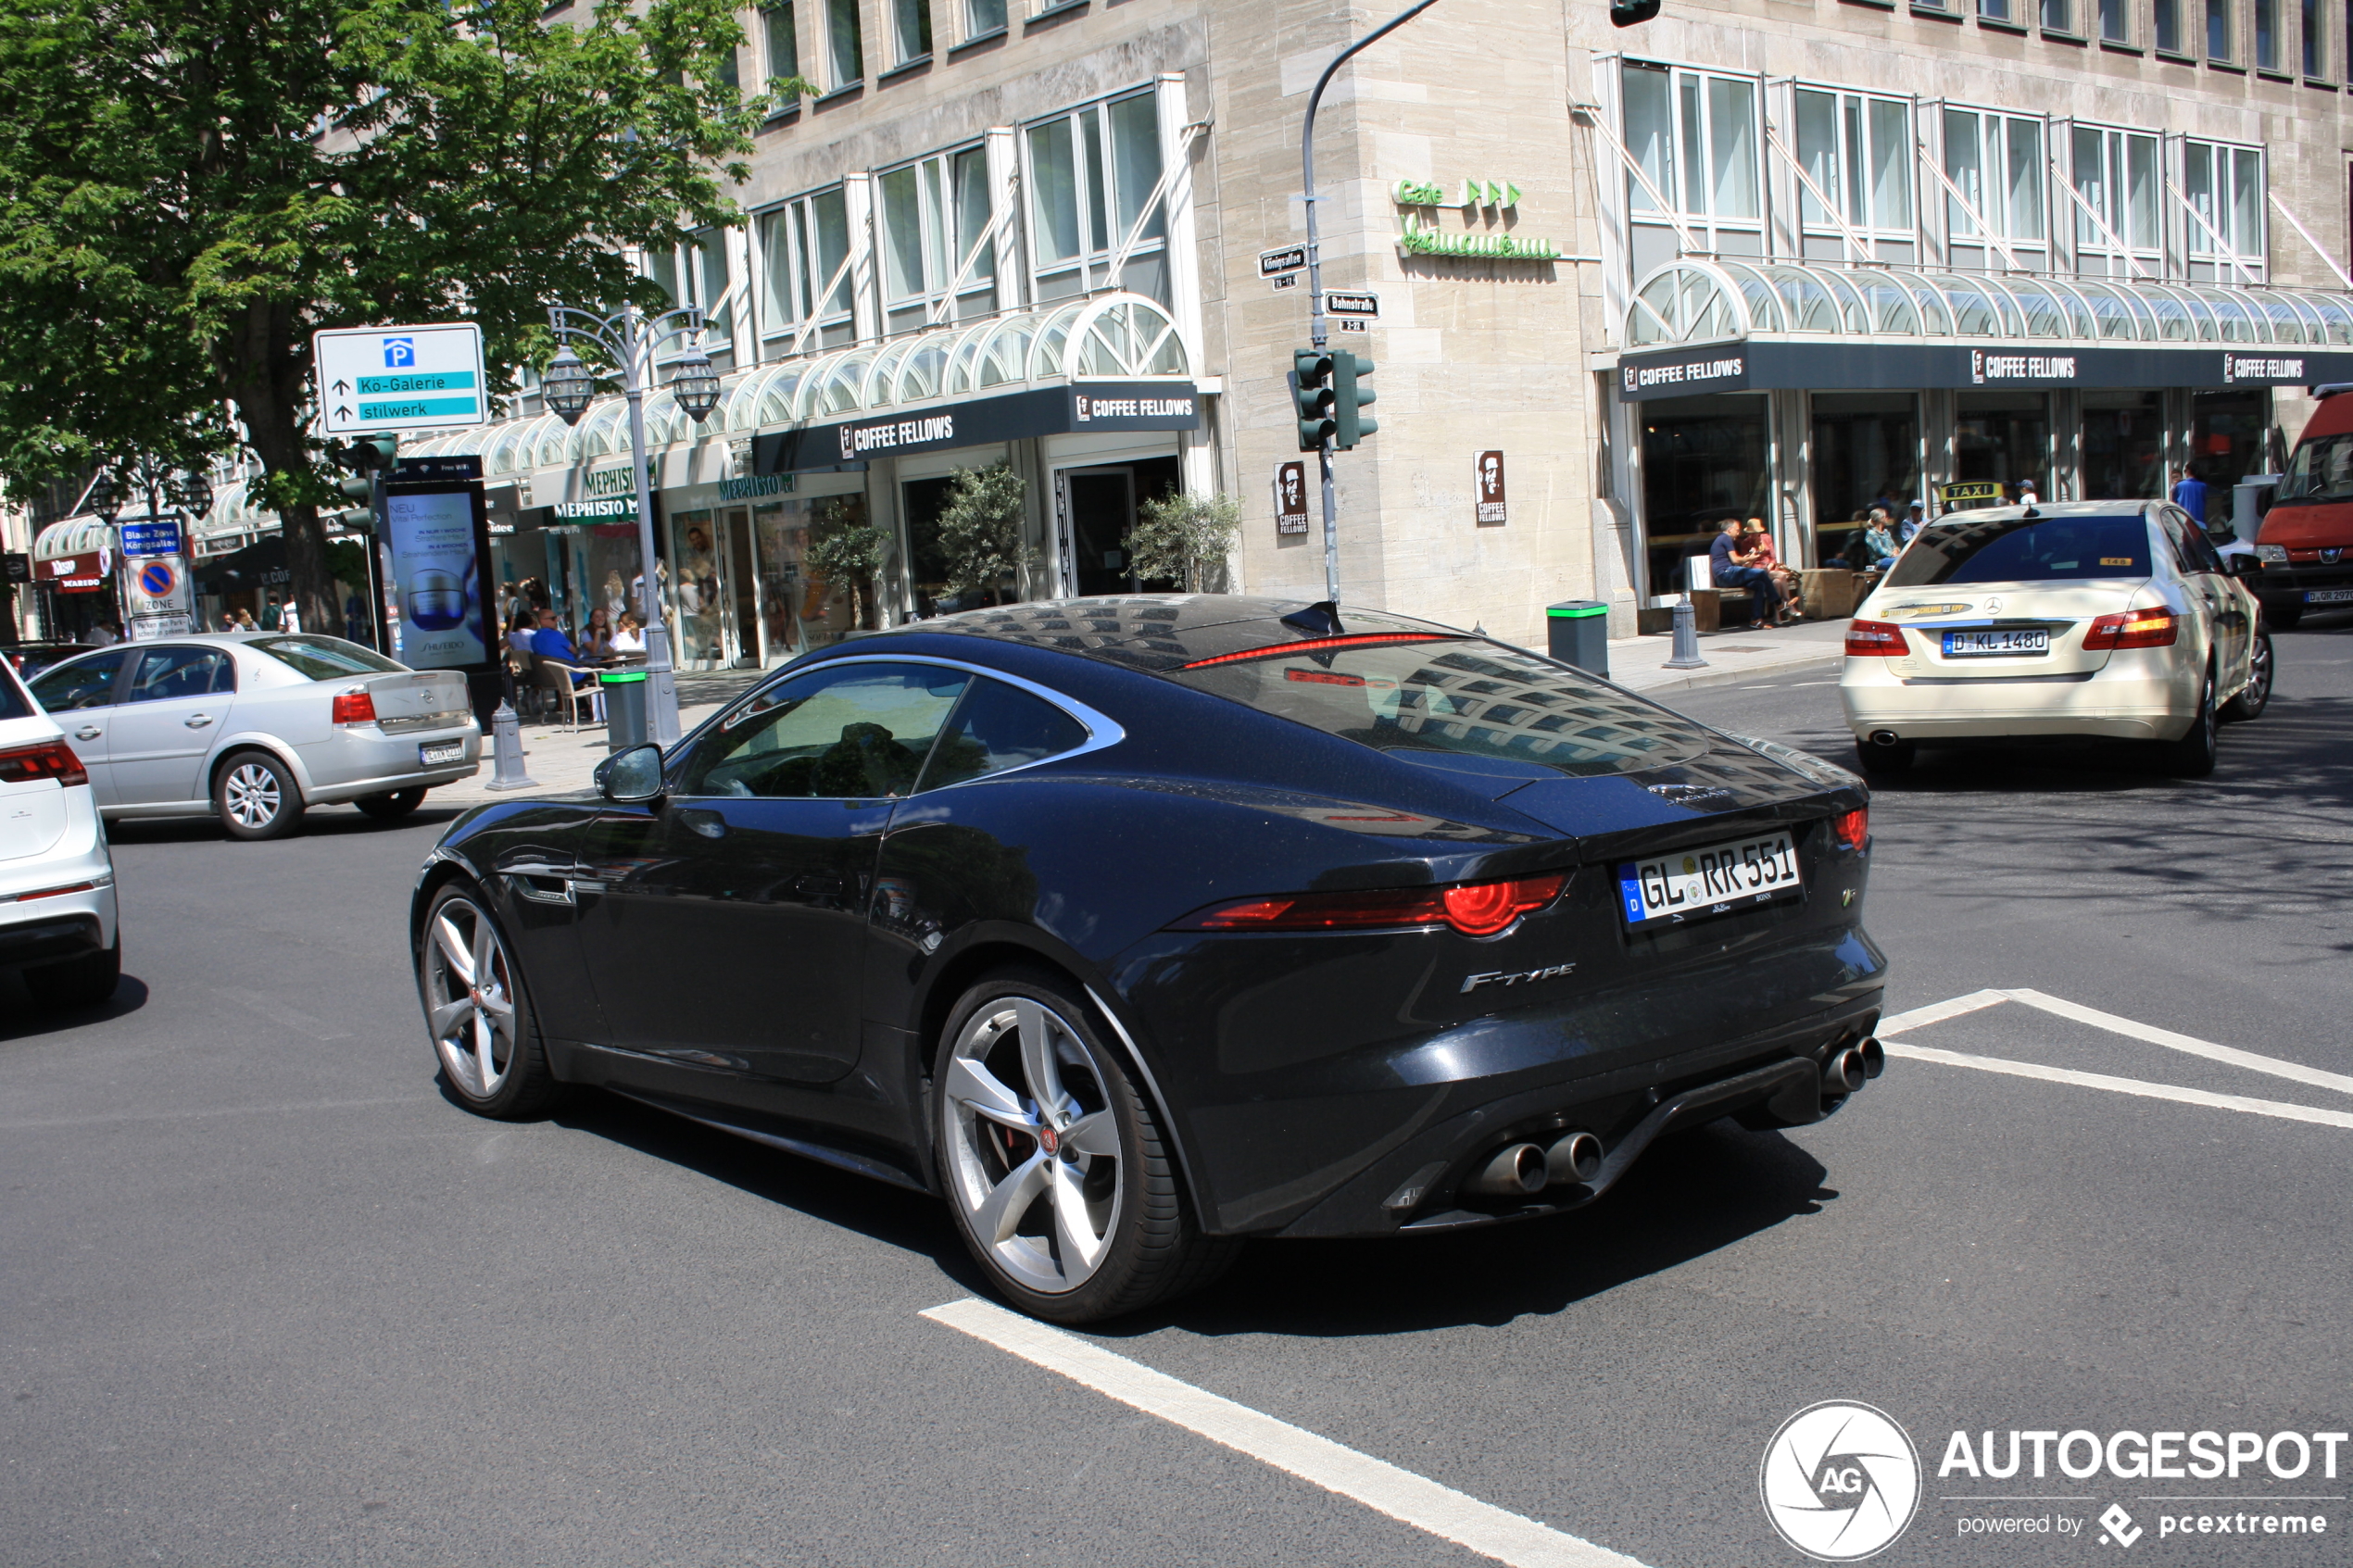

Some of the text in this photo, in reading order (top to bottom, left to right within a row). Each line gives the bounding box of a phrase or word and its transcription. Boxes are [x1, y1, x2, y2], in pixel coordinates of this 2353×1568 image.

[1264, 253, 1302, 270] Königsallee
[1331, 296, 1374, 311] Bahnstraße
[1347, 321, 1360, 330] 2-22
[1639, 358, 1742, 386] COFFEE FELLOWS
[1985, 357, 2075, 378] COFFEE FELLOWS
[2234, 358, 2303, 378] COFFEE FELLOWS
[361, 376, 446, 393] Kö-Galerie
[364, 403, 427, 420] stilwerk
[1092, 400, 1137, 418] COFFEE
[1139, 399, 1192, 417] FELLOWS
[854, 415, 953, 452] COFFEE FELLOWS
[585, 467, 635, 497] MEPHIST
[719, 475, 781, 501] MEPHISTO
[1952, 485, 1988, 497] TAXI
[389, 504, 415, 513] NEU
[554, 500, 624, 518] MEPHISTO
[1478, 502, 1504, 514] COFFEE
[391, 514, 408, 522] Vital
[1279, 513, 1306, 526] COFFEE
[1478, 513, 1505, 522] FELLOWS
[125, 529, 175, 540] Blaue Zone
[1280, 524, 1307, 534] FELLOWS
[125, 540, 177, 550] Königsallee
[145, 599, 174, 610] ZONE
[1954, 634, 1964, 650] D
[1976, 634, 1997, 649] KL
[2002, 633, 2045, 648] 1480
[1641, 862, 1685, 909] GL
[1699, 848, 1742, 897] RR
[1742, 838, 1794, 887] 551
[1755, 892, 1771, 903] BONN
[1459, 962, 1576, 994] F-TYPE
